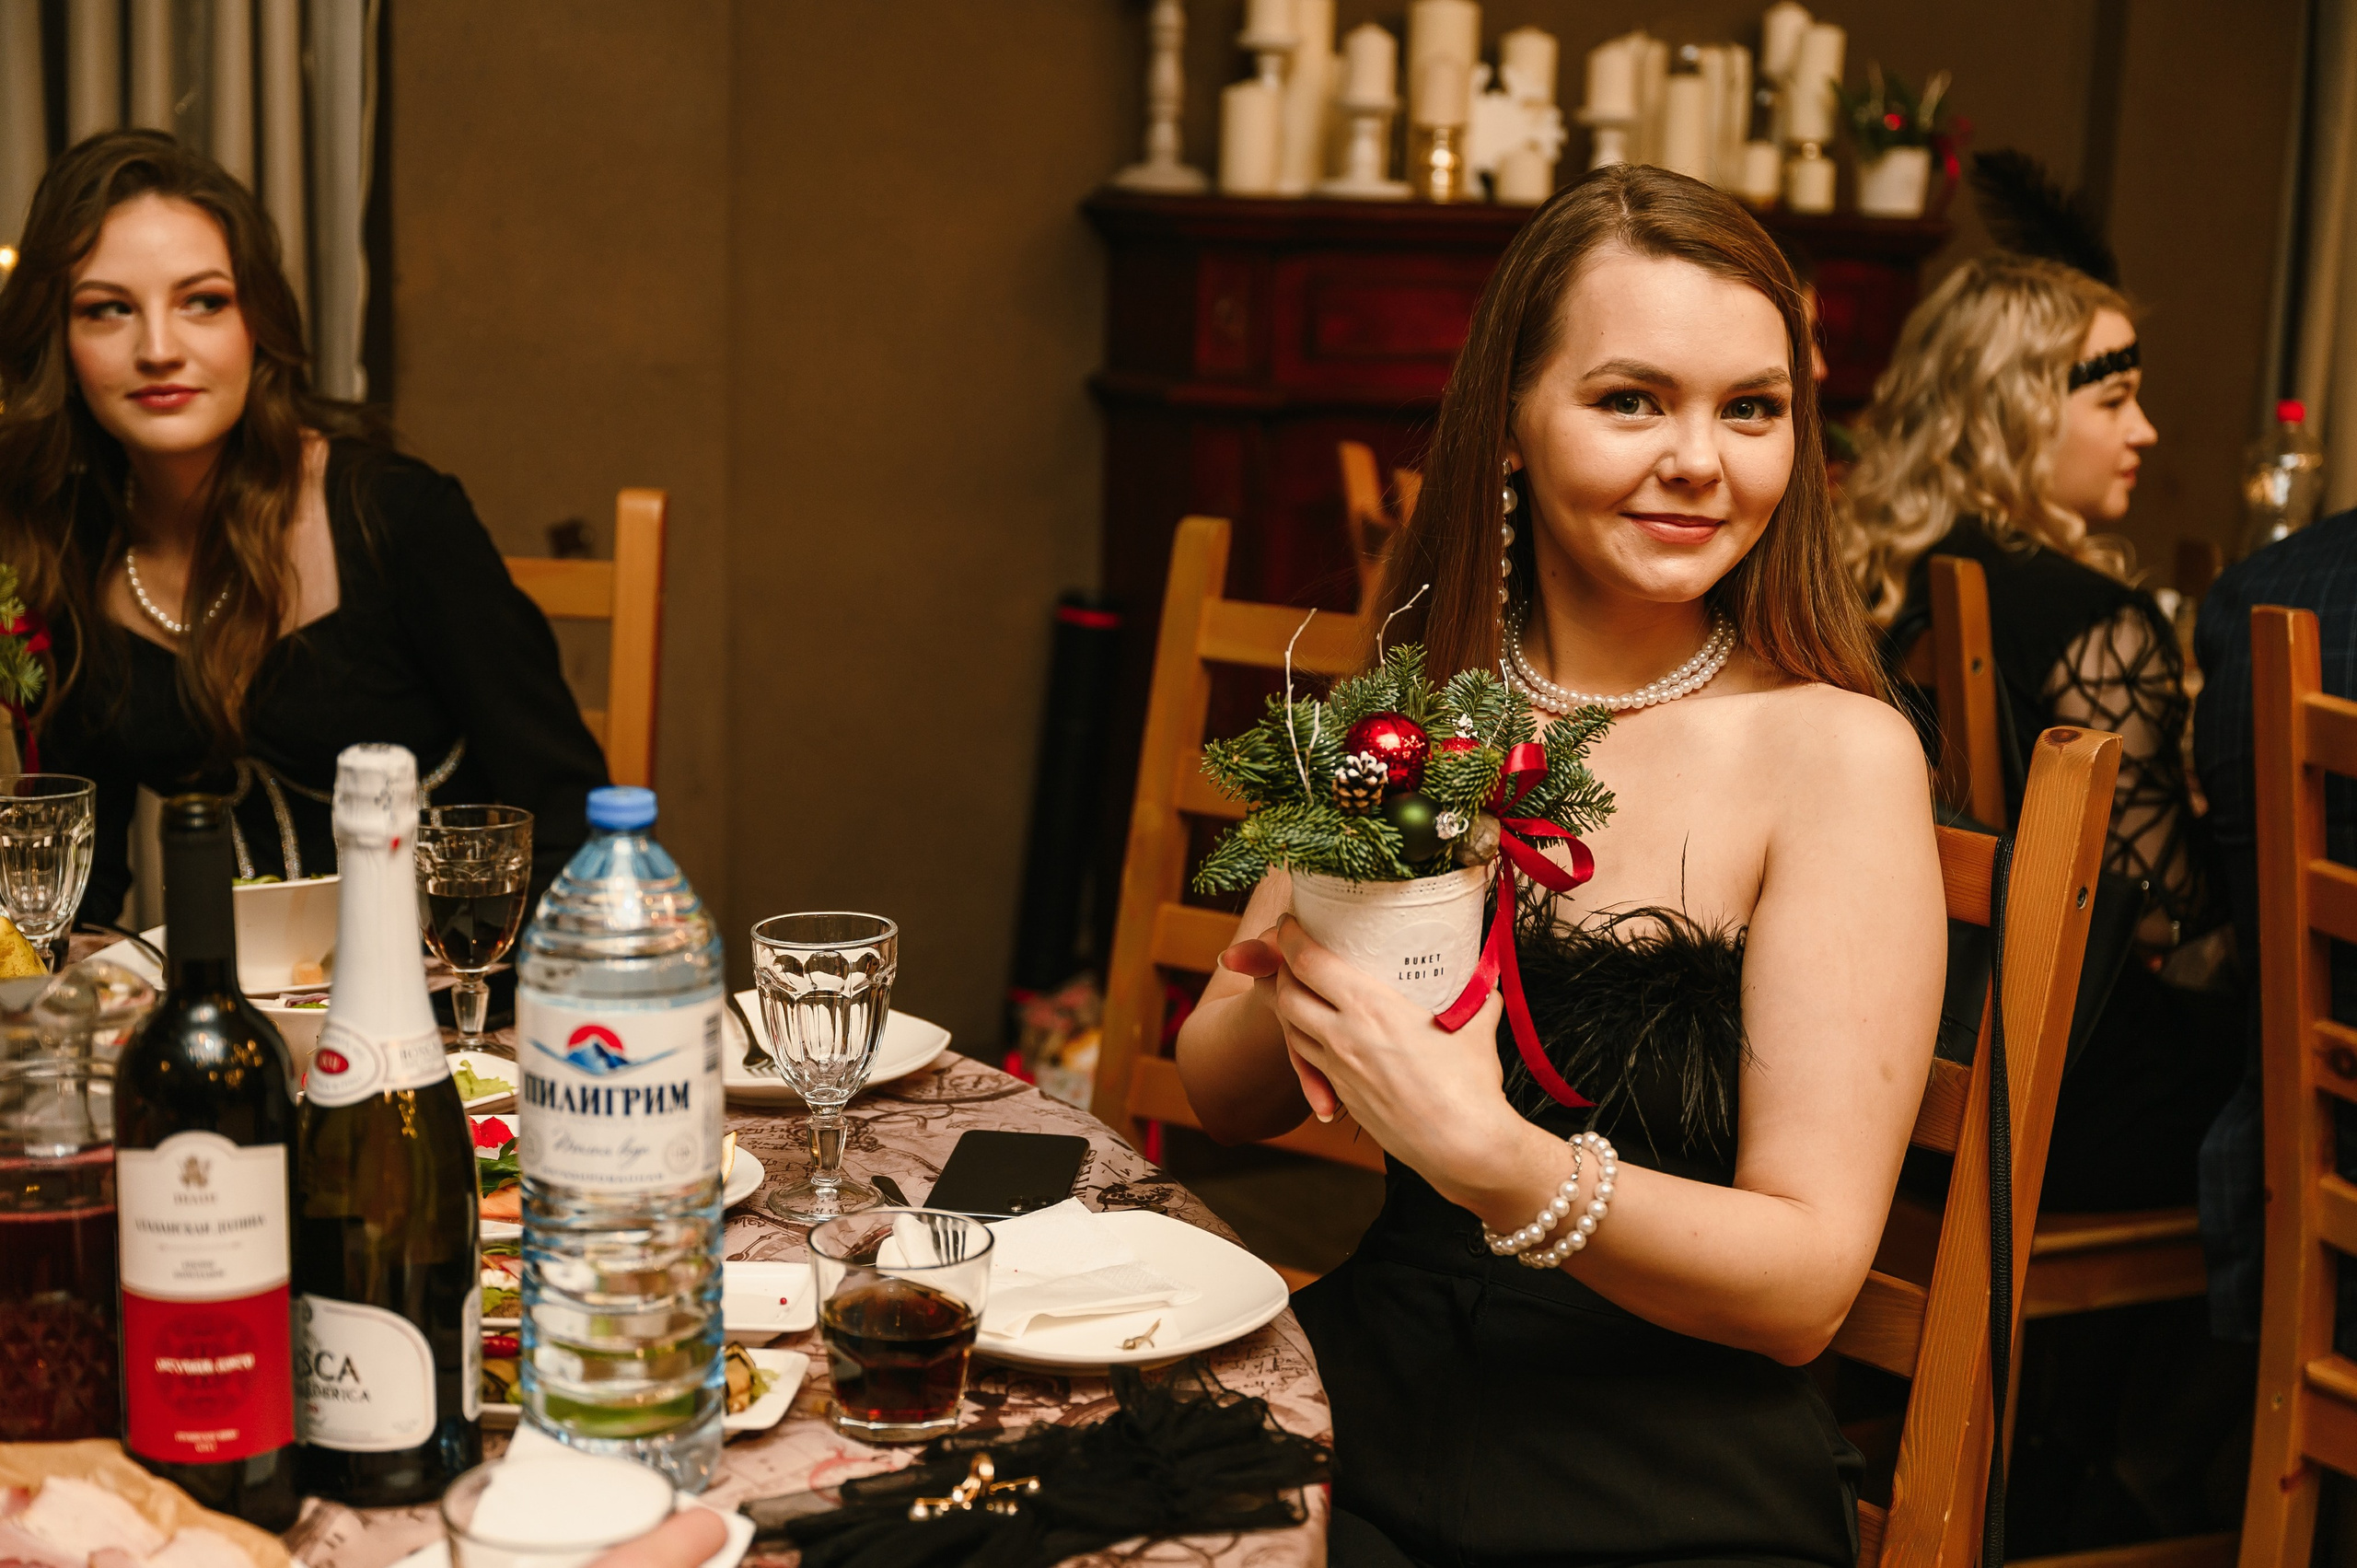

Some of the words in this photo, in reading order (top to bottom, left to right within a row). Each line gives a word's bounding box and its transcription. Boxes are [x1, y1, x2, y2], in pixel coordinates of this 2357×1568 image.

[1404, 953, 1441, 965] BUKET
[1399, 970, 1426, 980] LEDI
[1434, 967, 1444, 977] DI
[525, 1071, 690, 1116] ПИЛИГРИМ
